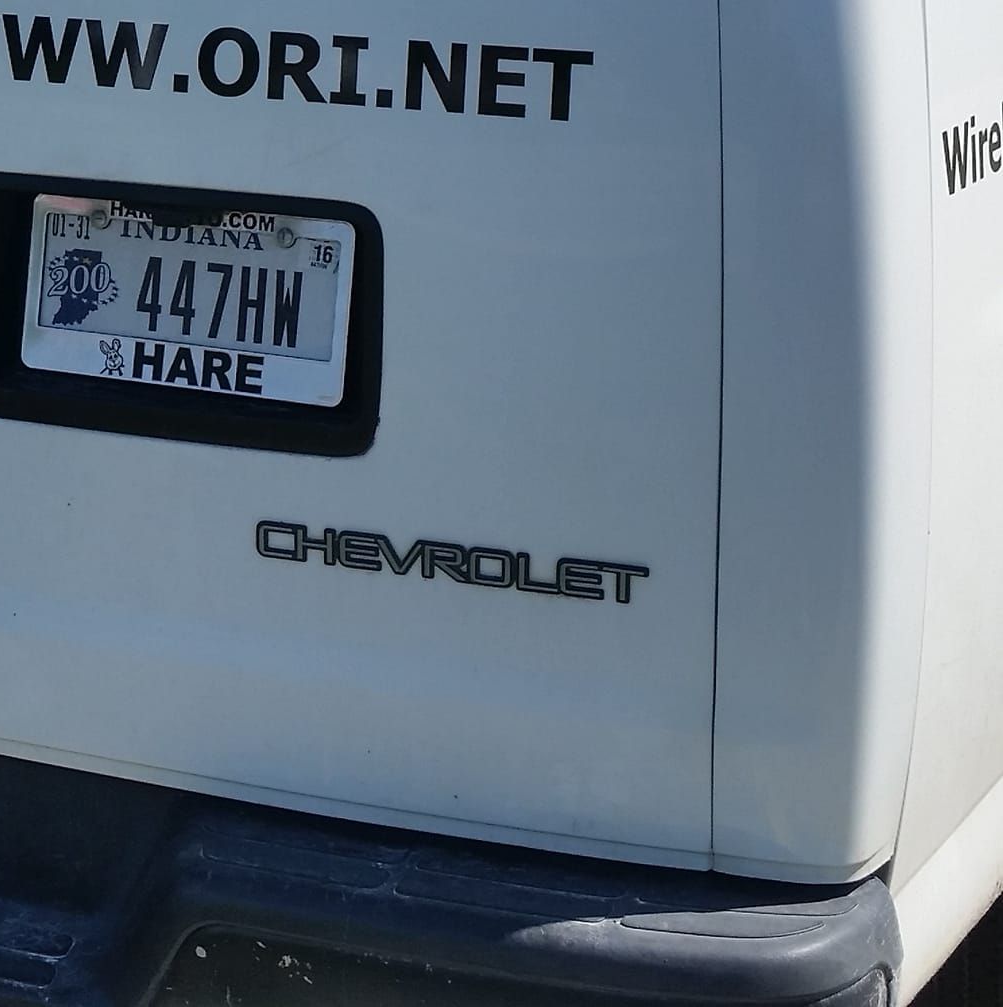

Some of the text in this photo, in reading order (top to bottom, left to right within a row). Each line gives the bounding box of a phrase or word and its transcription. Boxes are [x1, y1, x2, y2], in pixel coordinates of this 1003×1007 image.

[942, 101, 1003, 195] Wire
[47, 262, 112, 297] 200
[314, 244, 334, 264] 16
[136, 256, 303, 349] 447HW
[132, 342, 265, 394] HARE
[256, 520, 650, 604] CHEVROLET
